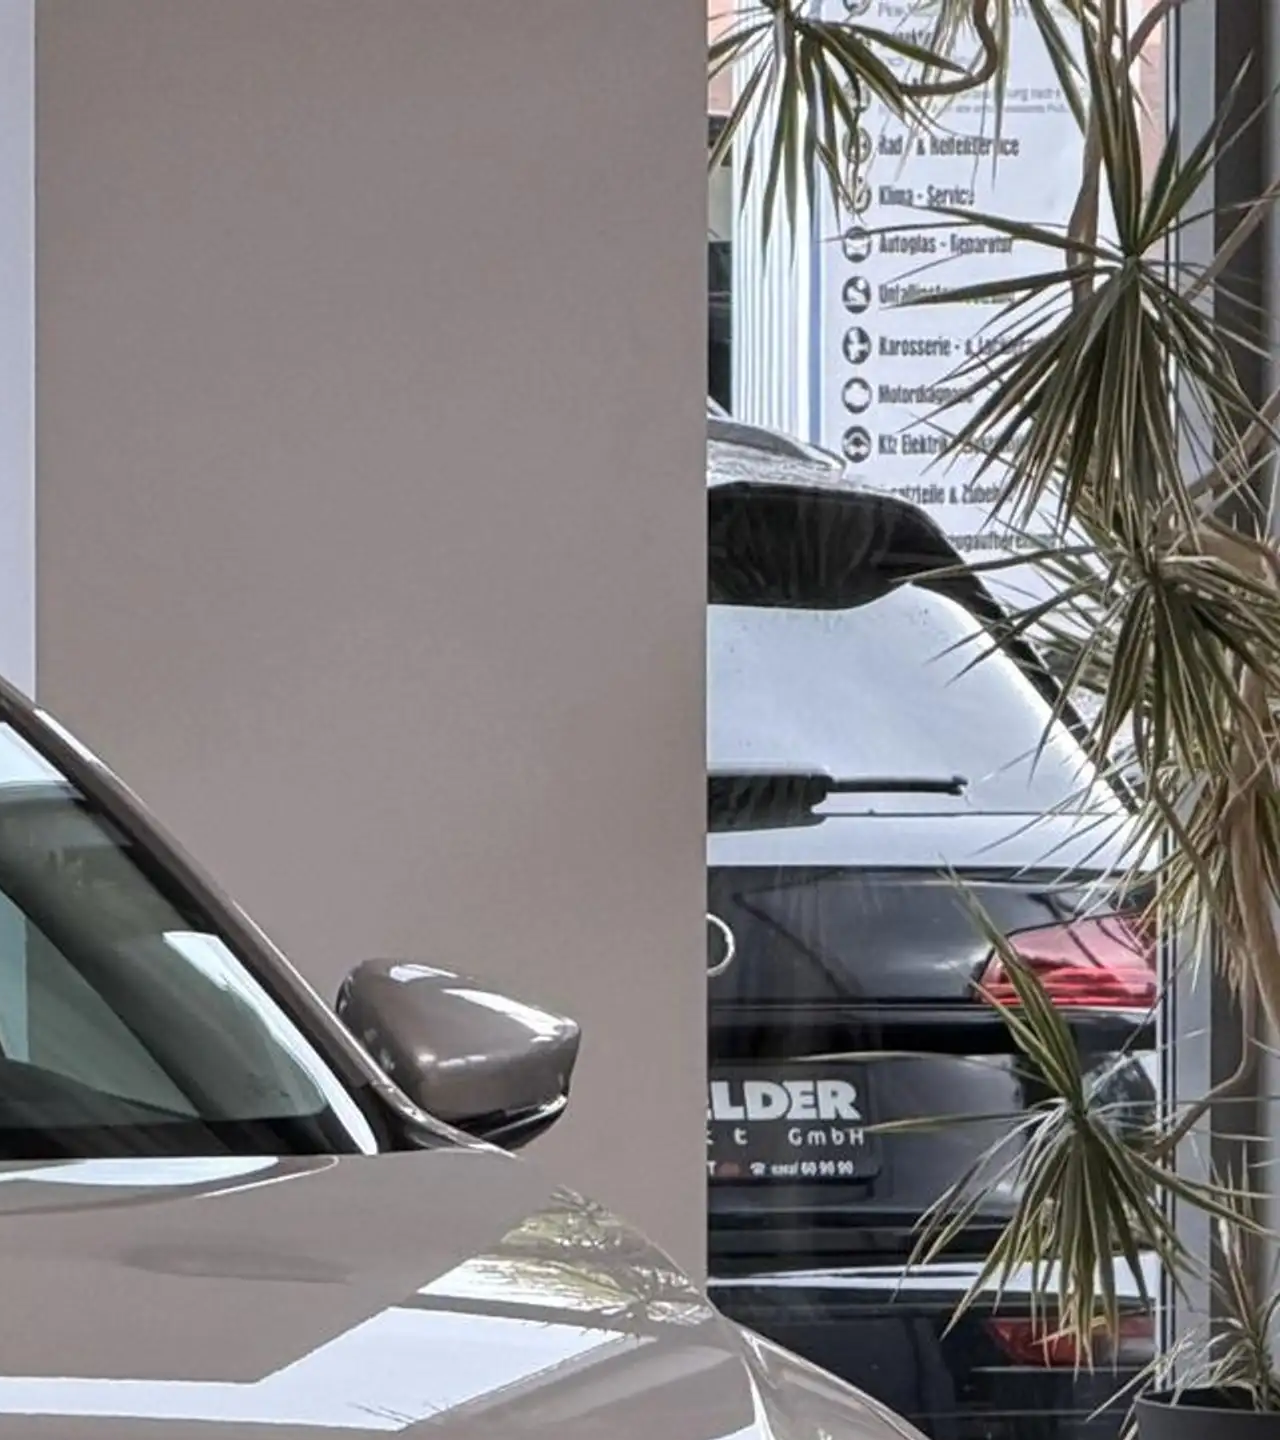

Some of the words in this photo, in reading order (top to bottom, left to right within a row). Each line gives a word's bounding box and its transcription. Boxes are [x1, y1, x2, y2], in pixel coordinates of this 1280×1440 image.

[879, 233, 937, 256] Autoglas
[878, 335, 952, 356] Karosserie
[706, 1080, 862, 1121] LDER
[787, 1127, 865, 1147] GmbH
